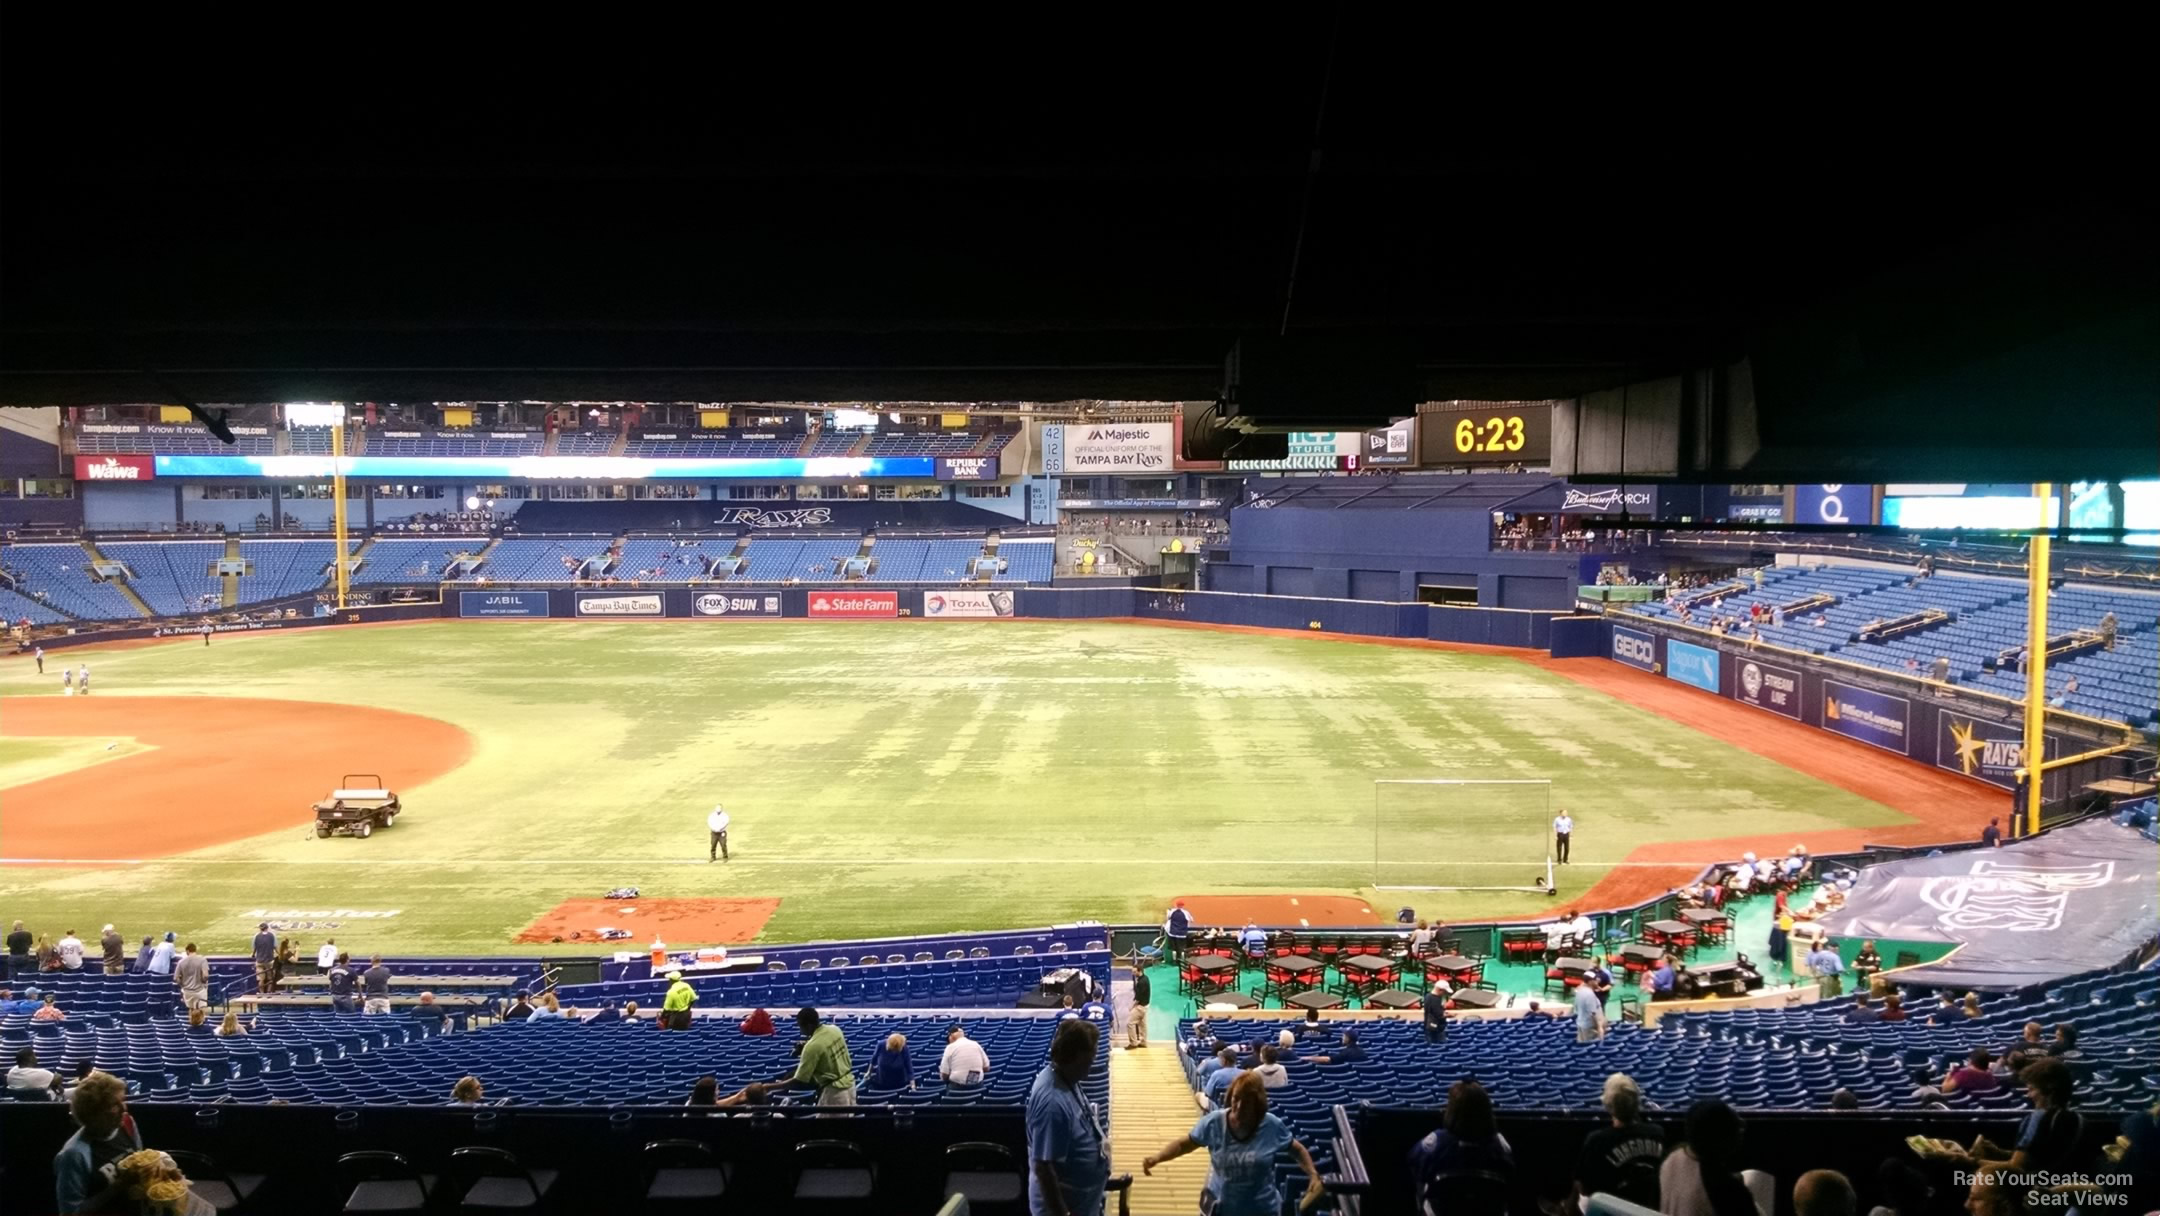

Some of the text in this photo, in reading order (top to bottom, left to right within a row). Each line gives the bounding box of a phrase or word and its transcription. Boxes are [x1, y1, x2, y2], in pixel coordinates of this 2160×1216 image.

[83, 424, 139, 434] tampabay.com
[147, 425, 206, 434] Know it now.
[1046, 428, 1060, 440] 42
[1105, 429, 1150, 443] Majestic
[1456, 416, 1525, 453] 6:23
[1047, 444, 1058, 454] 12
[946, 458, 987, 468] REPUBLIC
[1046, 459, 1060, 471] 66
[1075, 456, 1111, 465] TAMPA
[1113, 455, 1135, 465] BAY
[88, 464, 139, 479] Wawa
[954, 467, 980, 475] BANK
[1611, 493, 1650, 504] PORCH
[485, 596, 523, 604] JABIL
[704, 598, 757, 611] FOX SUN
[949, 600, 988, 608] TOTAL
[584, 600, 657, 612] Tampa Bay Times
[899, 608, 911, 616] 370
[174, 625, 214, 634] Petersbg
[1614, 634, 1653, 664] GEICO
[1982, 740, 2021, 767] RAYS
